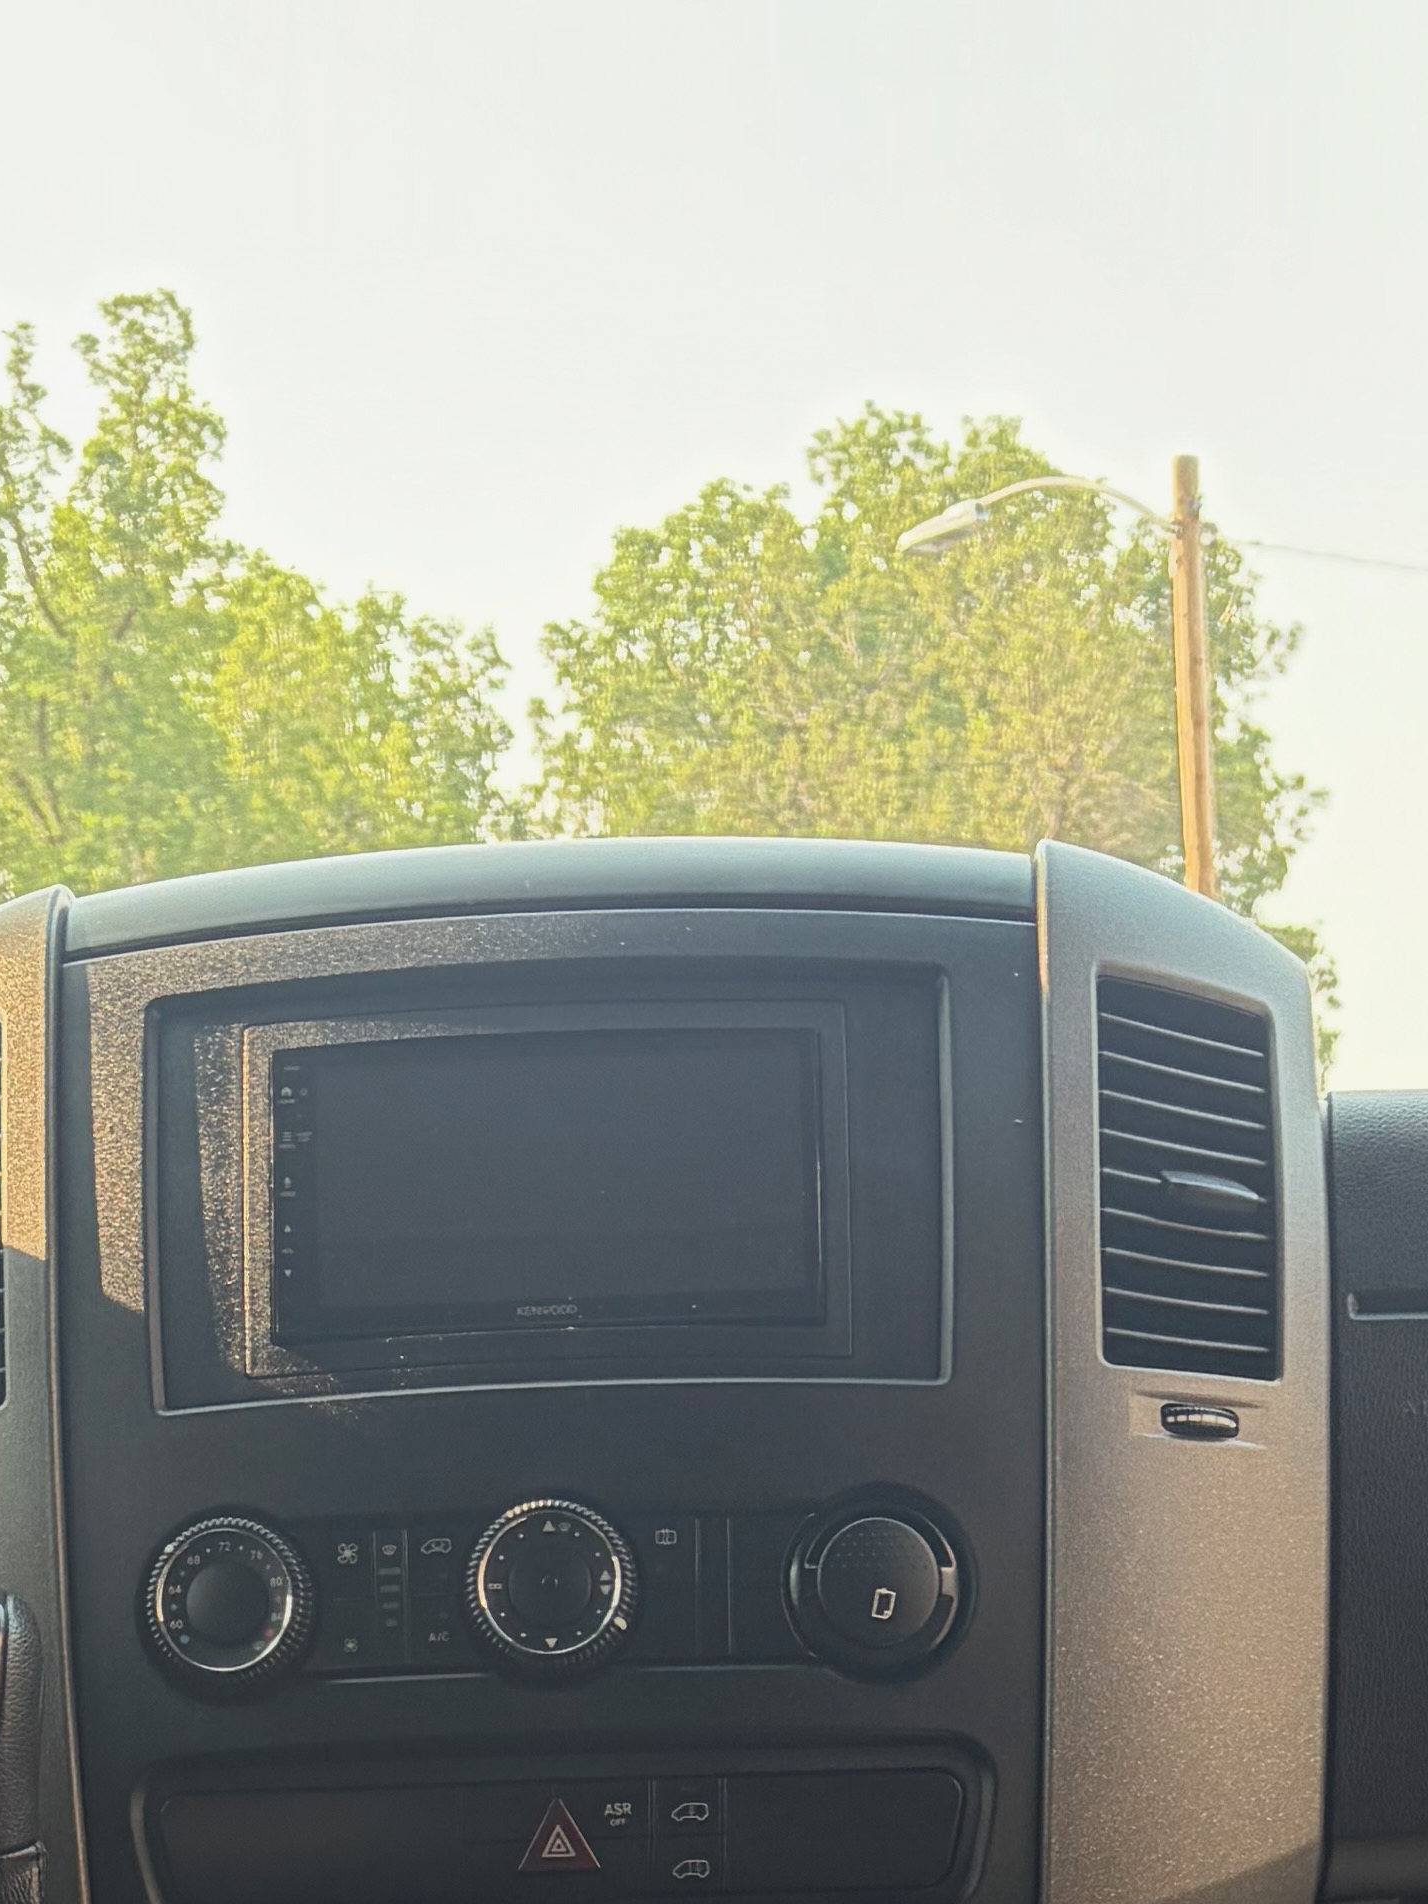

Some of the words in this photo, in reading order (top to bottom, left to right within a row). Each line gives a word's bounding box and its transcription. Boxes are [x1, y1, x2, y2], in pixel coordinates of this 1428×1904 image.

[516, 1304, 578, 1316] KENWOOD
[218, 1541, 231, 1552] 72
[187, 1555, 201, 1566] 68
[168, 1585, 182, 1594] 64
[169, 1619, 184, 1630] 60
[428, 1631, 450, 1642] A/C
[604, 1802, 632, 1816] ASR
[609, 1818, 626, 1827] OFF
